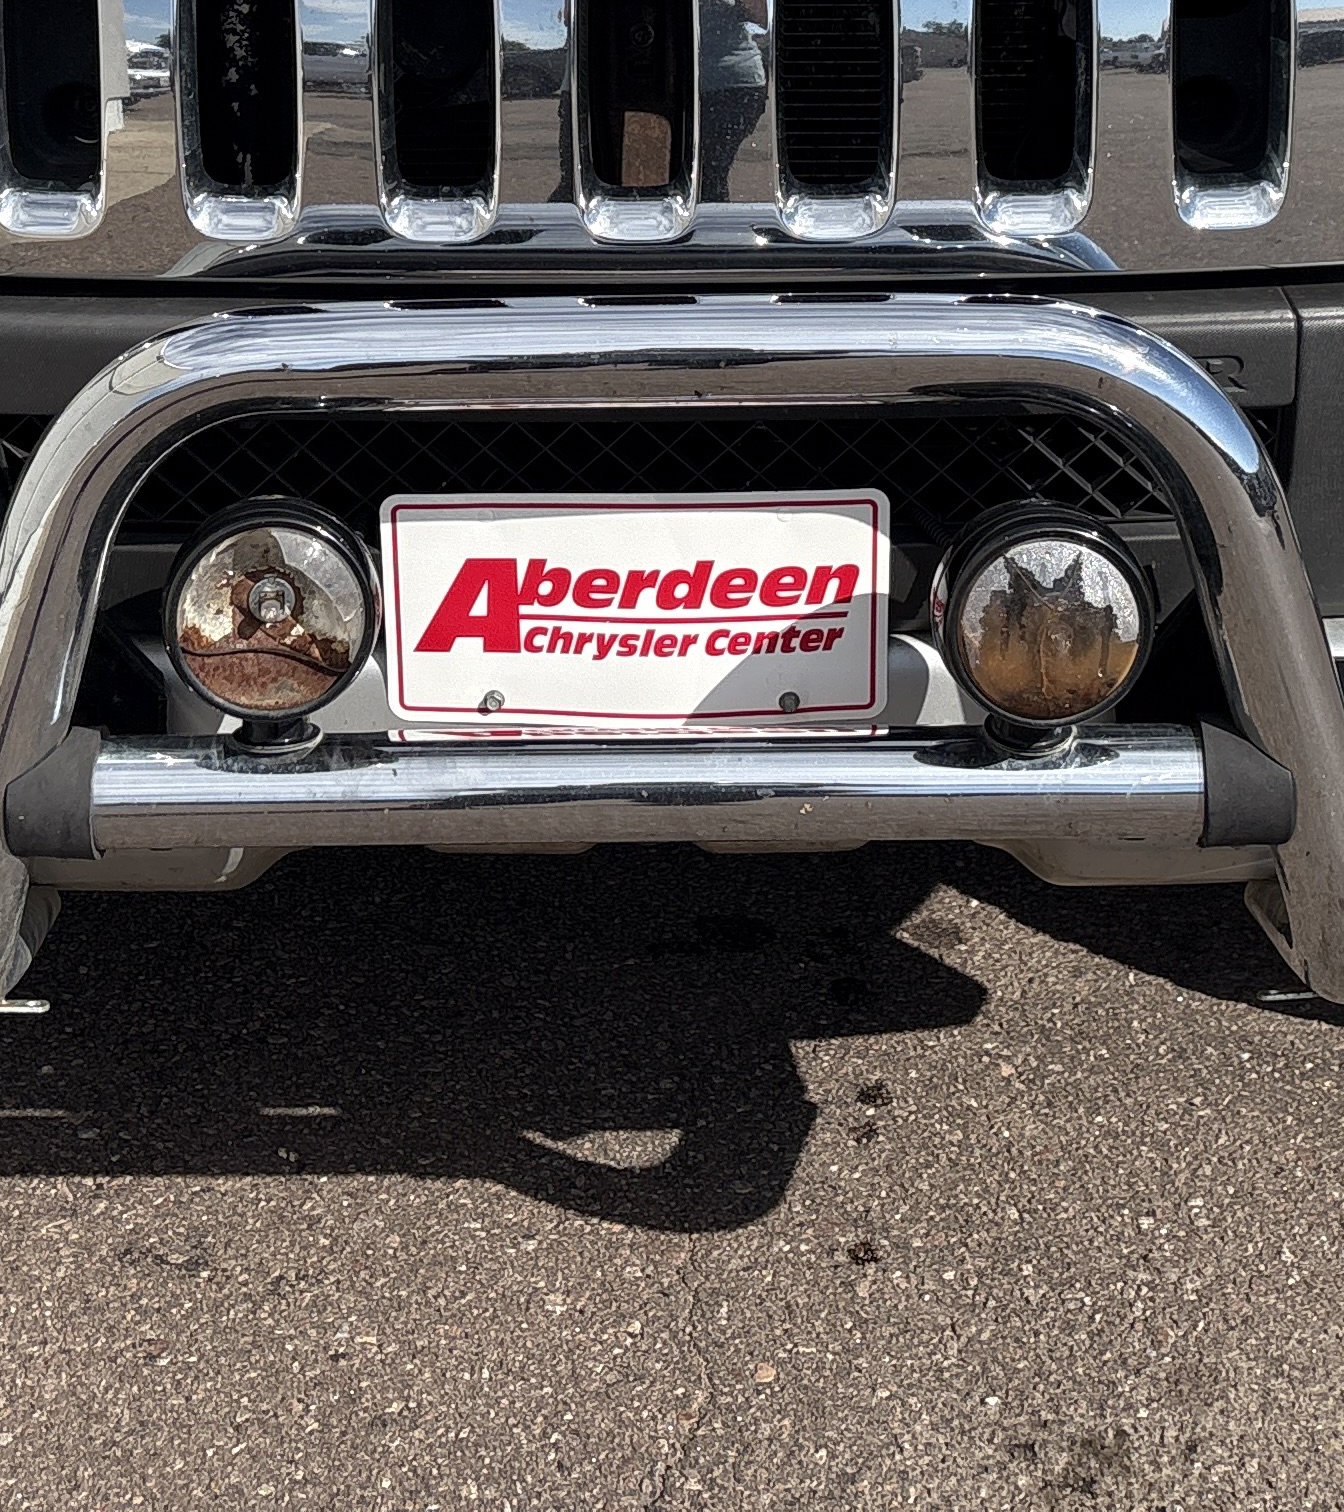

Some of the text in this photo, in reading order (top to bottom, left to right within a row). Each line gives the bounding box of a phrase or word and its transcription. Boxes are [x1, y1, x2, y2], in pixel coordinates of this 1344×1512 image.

[413, 557, 860, 653] Aberdeen
[523, 625, 846, 661] Chrysler Center
